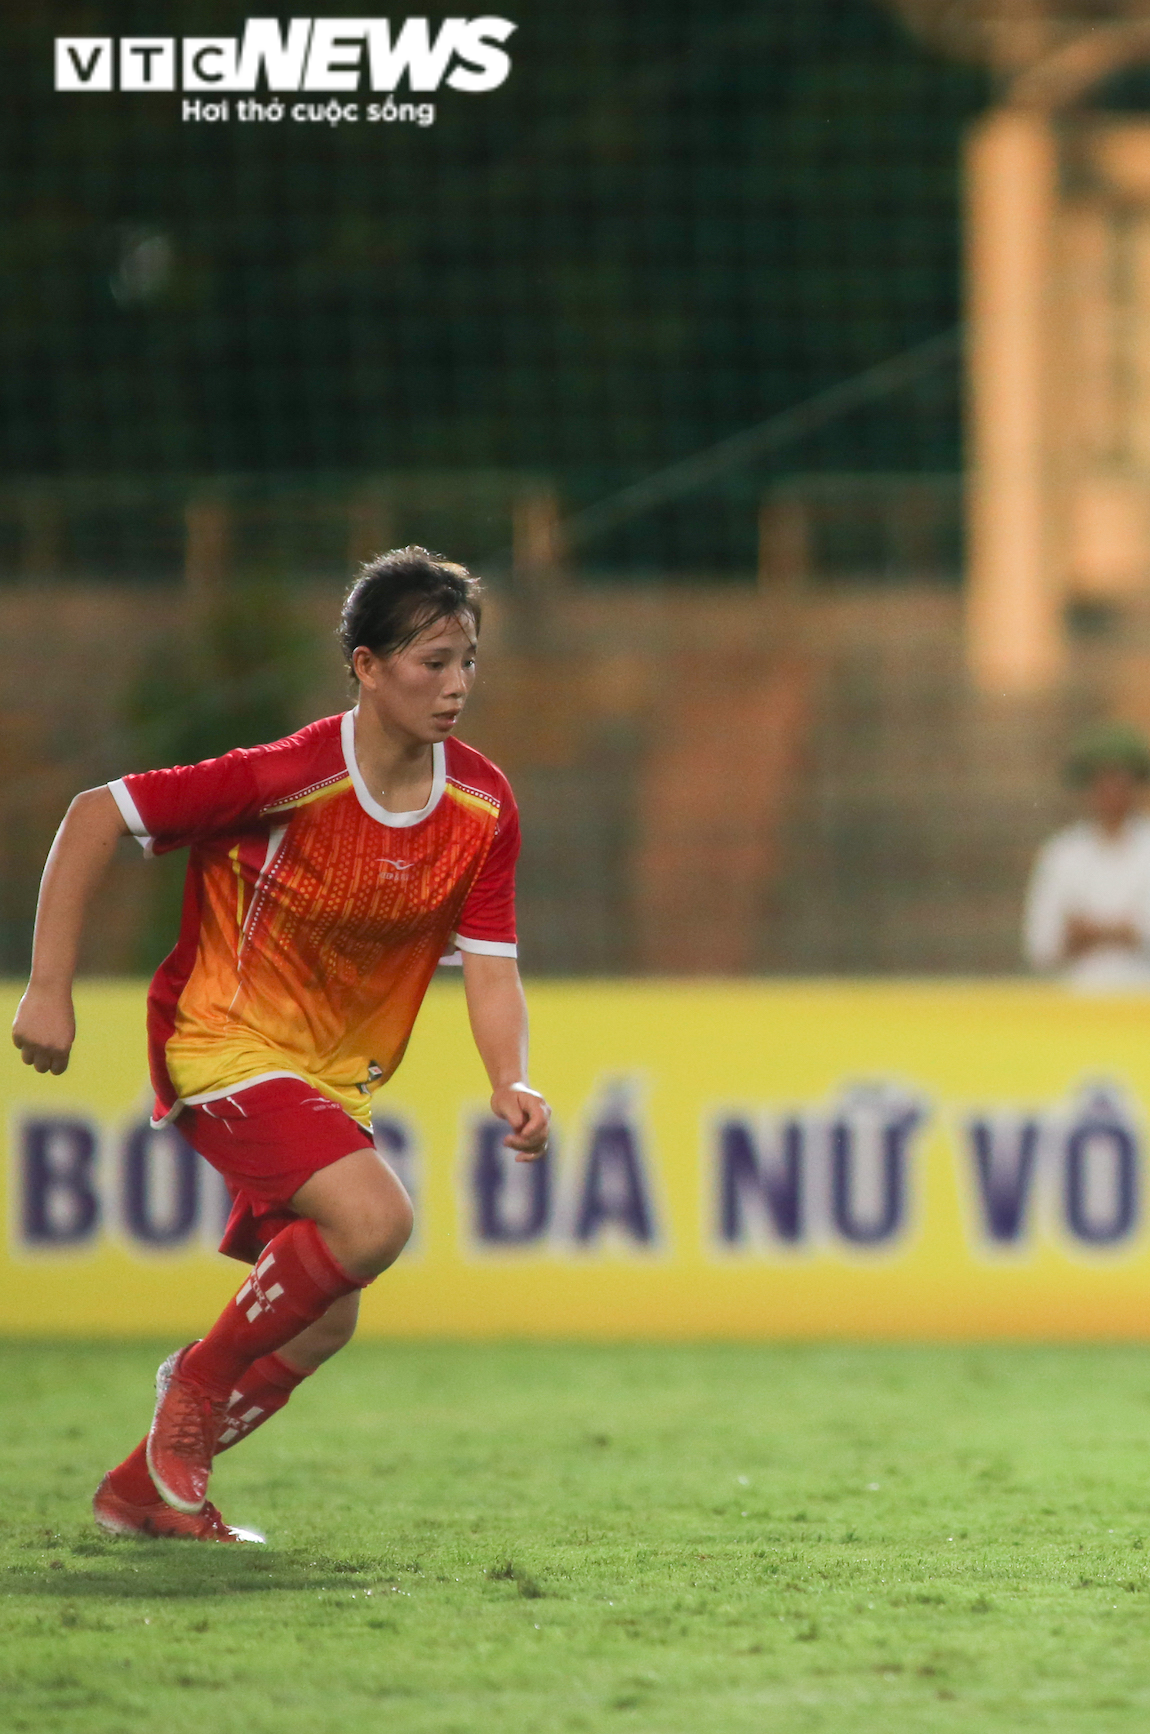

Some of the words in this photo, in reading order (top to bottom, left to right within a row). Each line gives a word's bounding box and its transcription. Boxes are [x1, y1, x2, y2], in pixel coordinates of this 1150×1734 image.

[474, 1076, 656, 1246] ĐÁ
[718, 1080, 922, 1248] NỮ
[970, 1078, 1142, 1250] VÔ
